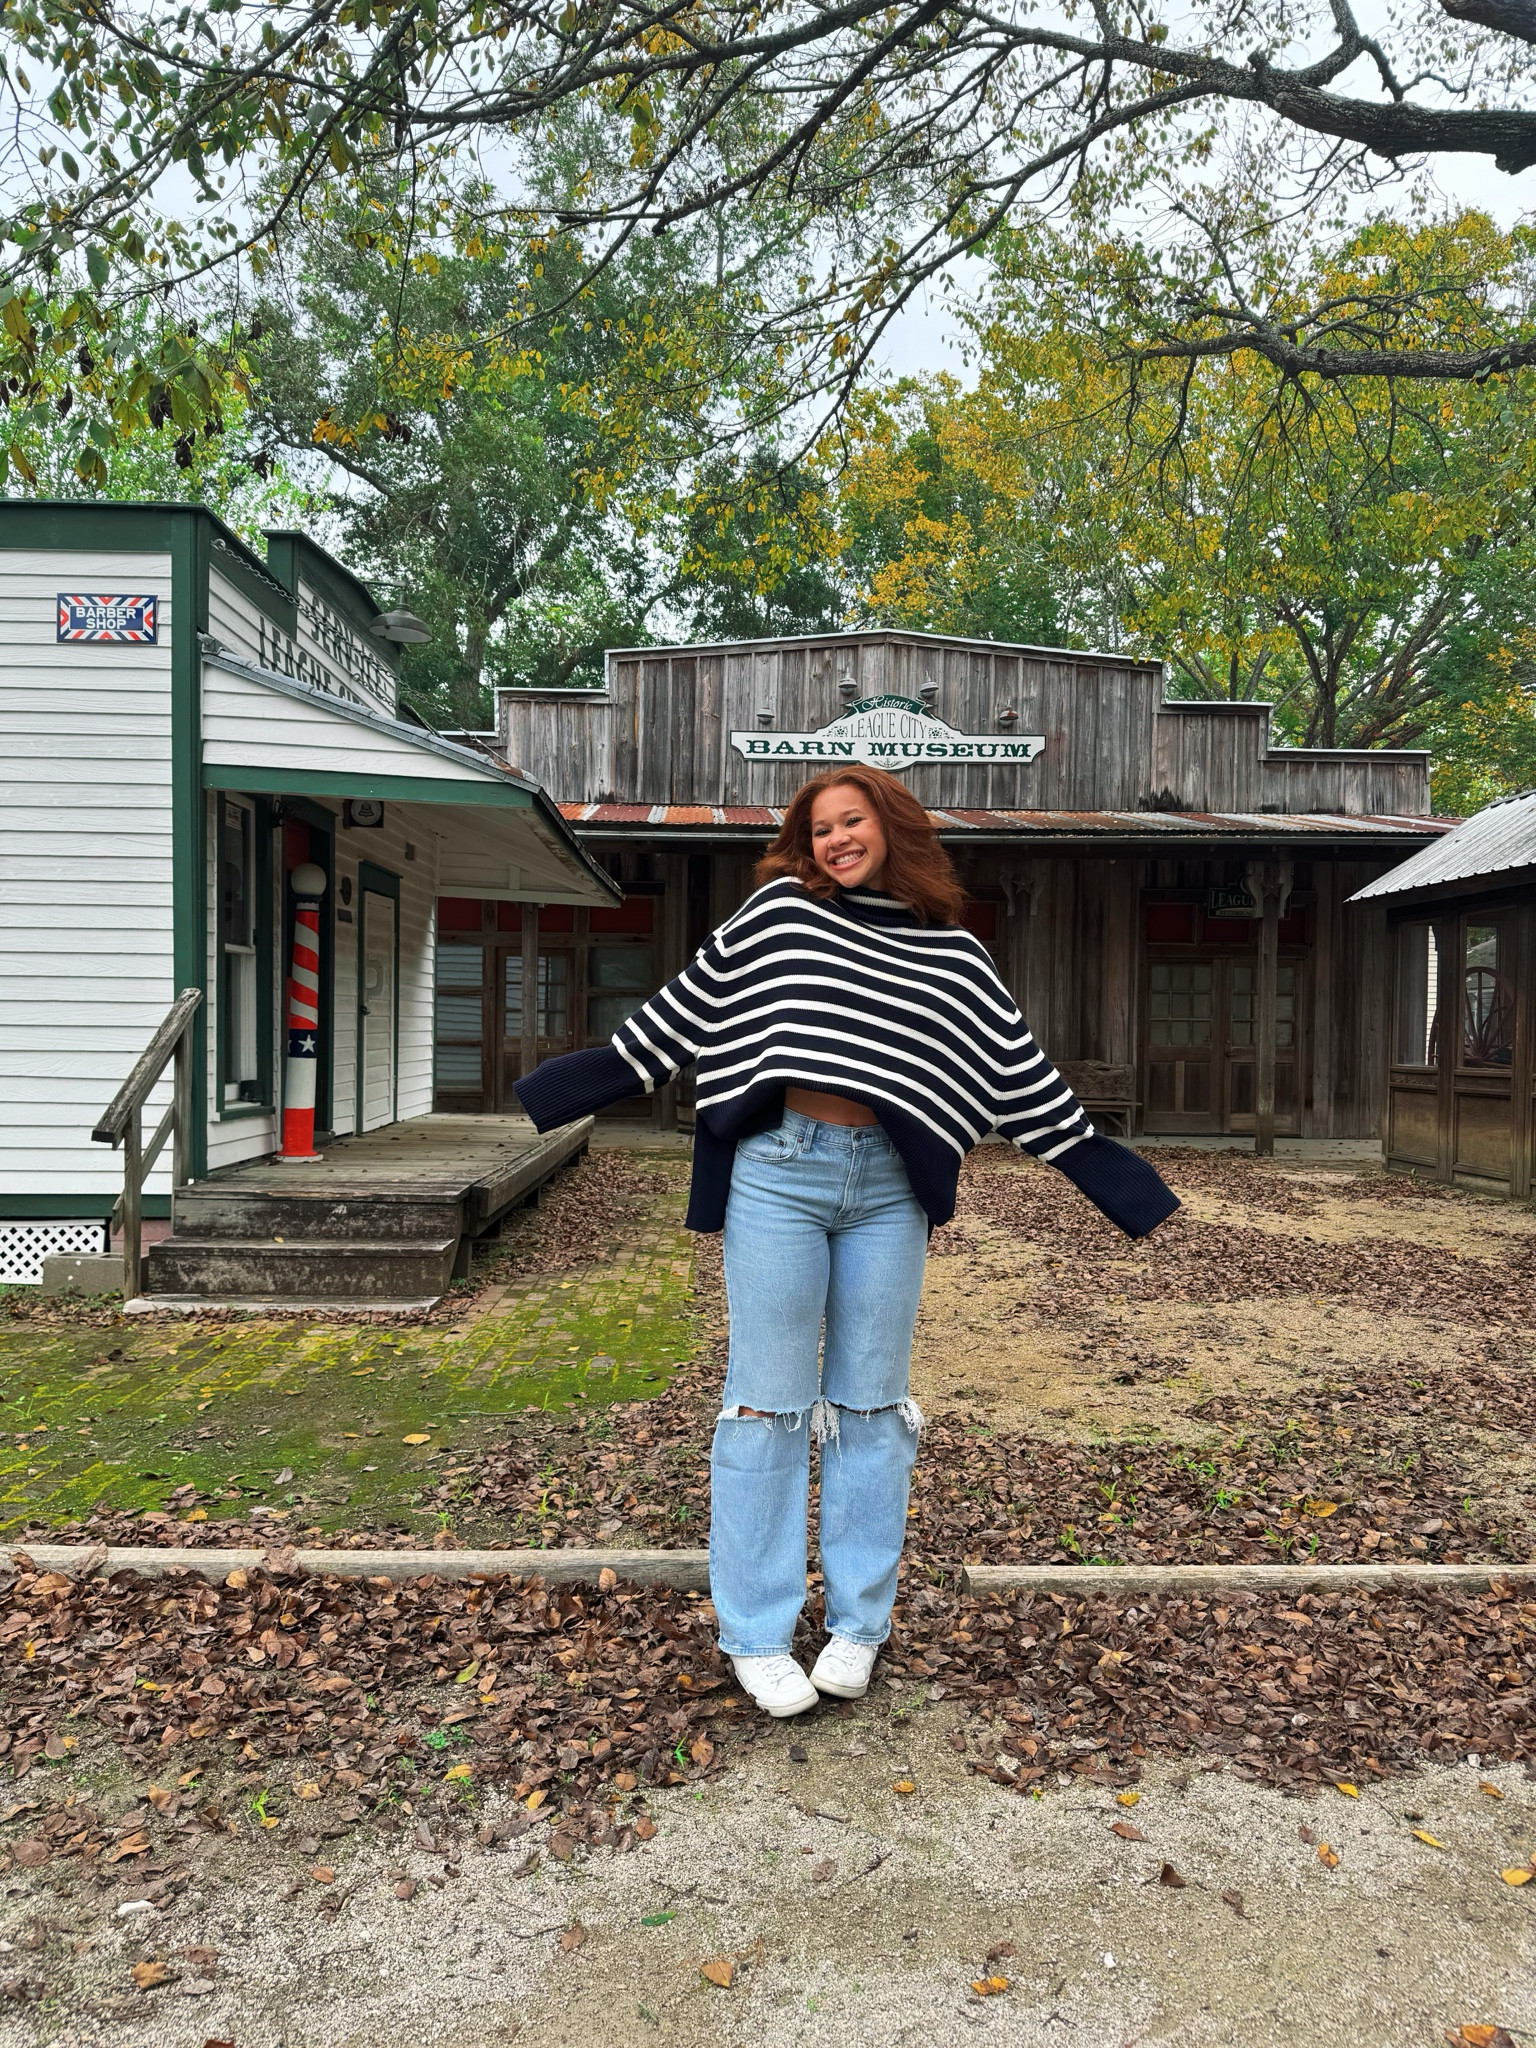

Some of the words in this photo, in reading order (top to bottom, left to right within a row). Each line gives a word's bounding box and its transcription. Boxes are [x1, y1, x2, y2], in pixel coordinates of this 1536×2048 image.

[75, 607, 136, 619] BARBER
[86, 618, 127, 630] SHOP
[861, 695, 913, 711] Historic
[850, 712, 896, 739] LEAGUE
[900, 713, 927, 739] CITY
[746, 739, 855, 756] BARN
[867, 742, 1032, 758] MUSEUM
[1211, 890, 1254, 908] LEAGU
